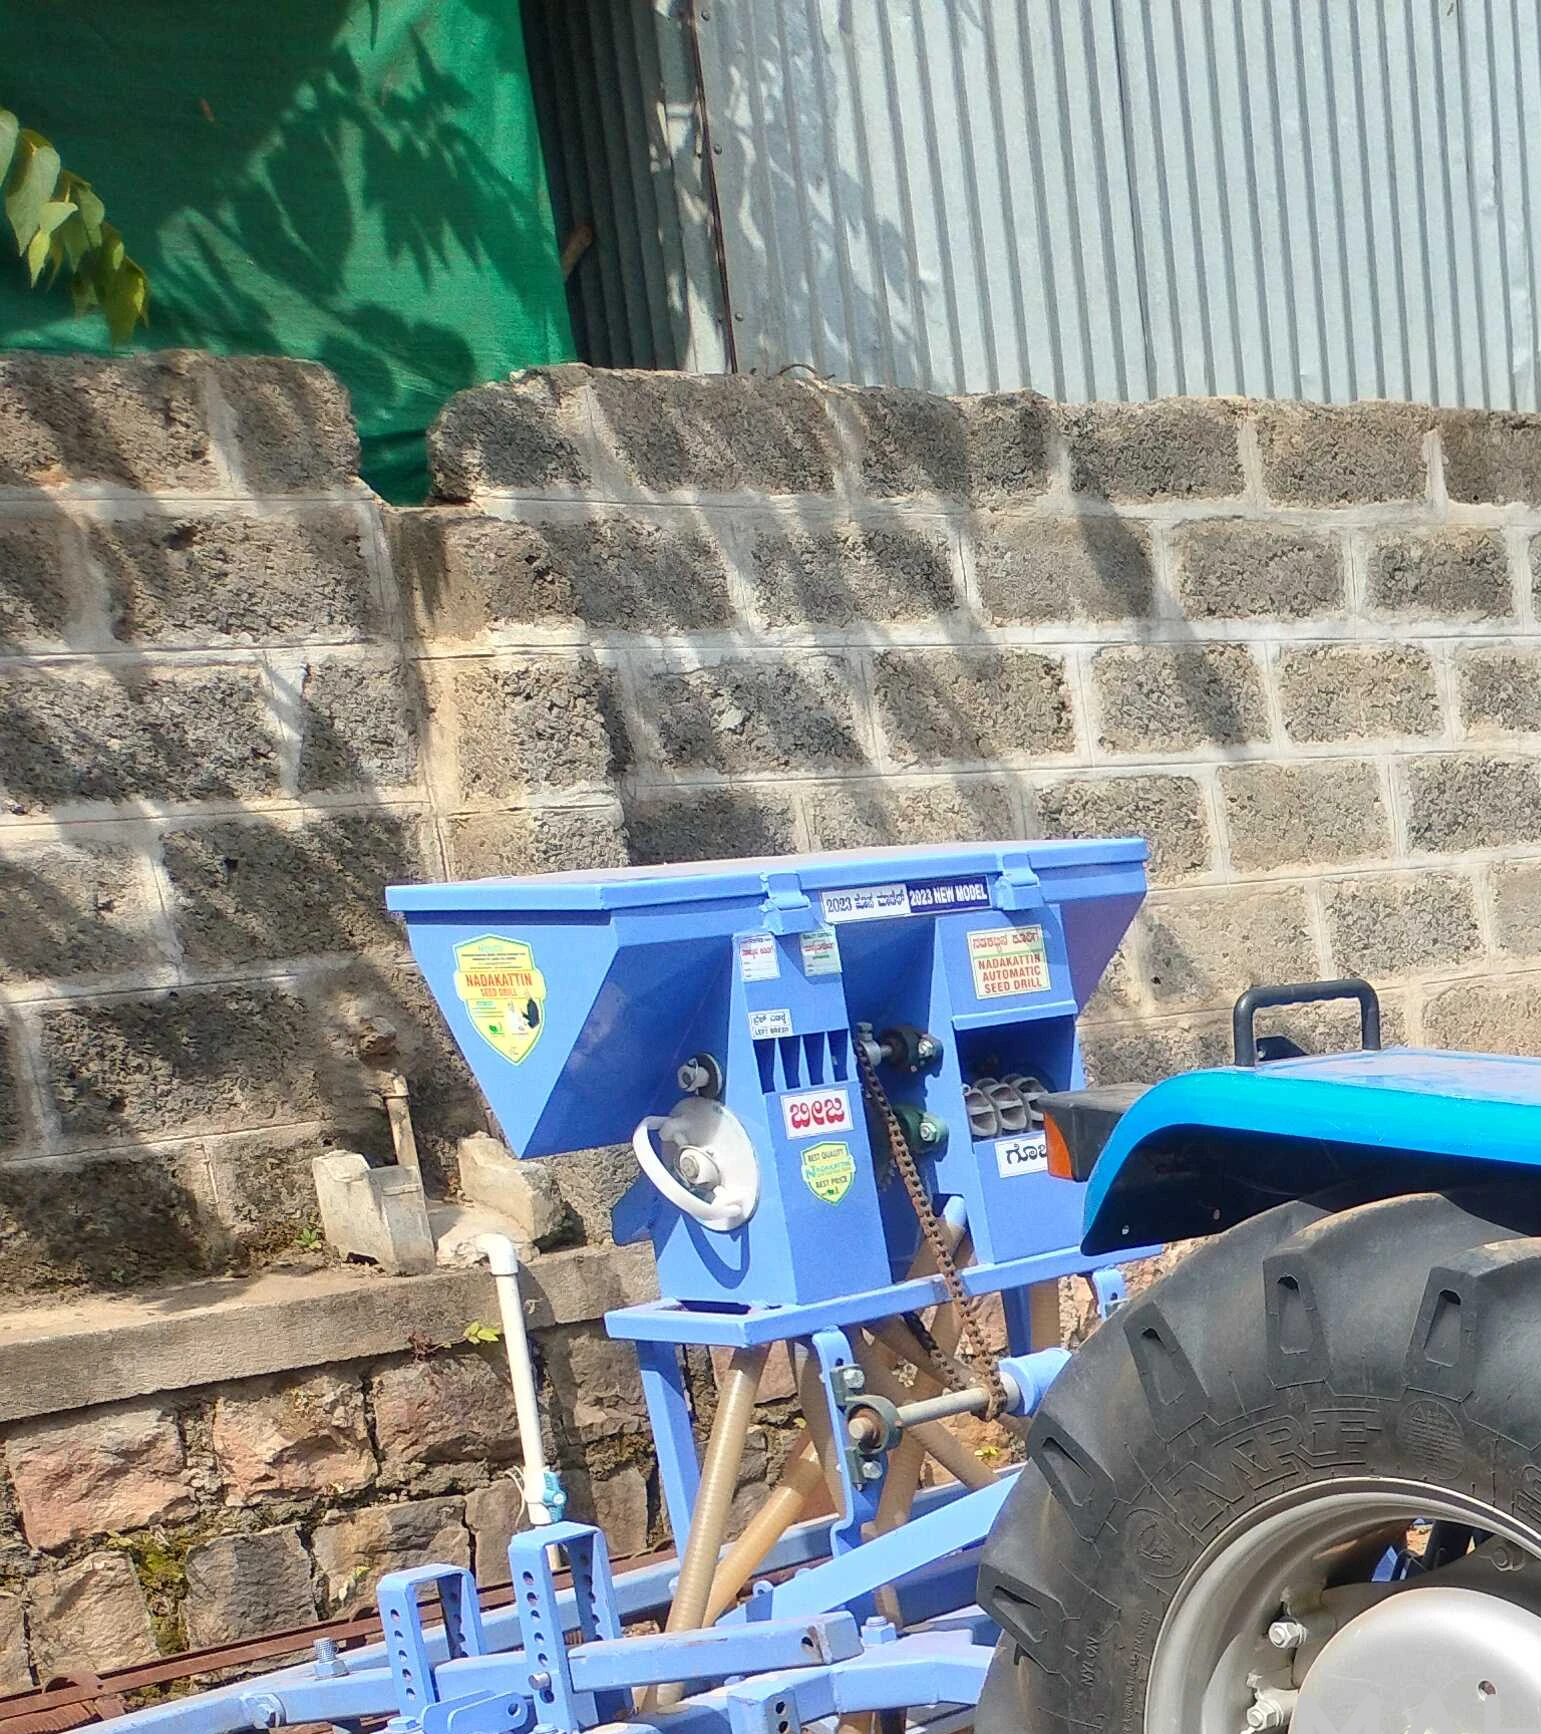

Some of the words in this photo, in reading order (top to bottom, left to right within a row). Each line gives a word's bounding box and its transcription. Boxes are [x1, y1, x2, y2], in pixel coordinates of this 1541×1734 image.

[909, 889, 932, 906] 2023
[934, 886, 953, 903] NEW
[955, 884, 987, 901] MODEL
[826, 896, 851, 912] 2023
[978, 953, 1041, 970] NADAKATTIN
[465, 973, 533, 987] NADAKATTIN
[983, 965, 1041, 982] AUTOMATIC
[984, 981, 1010, 994] SEED
[1014, 977, 1042, 990] DRILL
[790, 1097, 845, 1129] ಬೀಜ
[1078, 1632, 1101, 1688] NYLON
